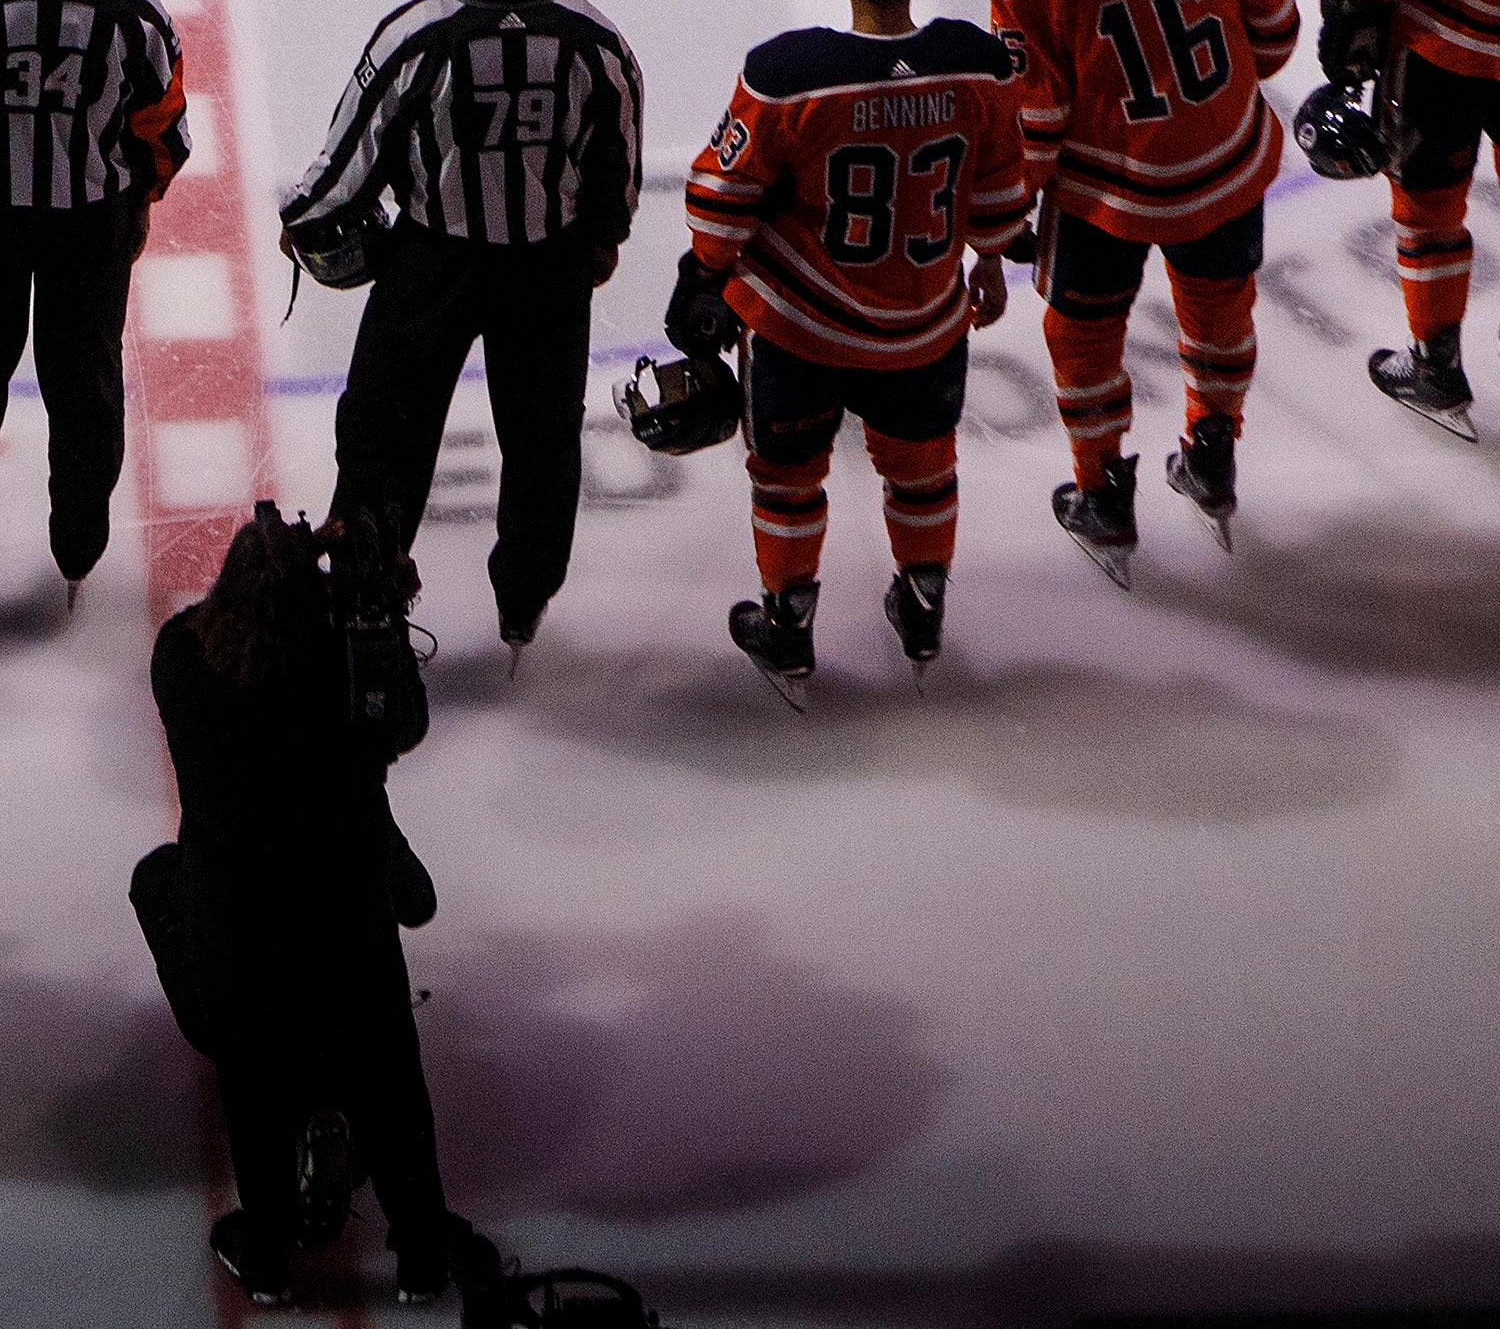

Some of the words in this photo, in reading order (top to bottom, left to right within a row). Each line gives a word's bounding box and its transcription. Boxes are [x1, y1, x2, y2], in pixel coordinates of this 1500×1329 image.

[3, 49, 85, 110] 34
[472, 87, 556, 148] 79
[851, 90, 957, 134] BENNING
[821, 133, 969, 270] 83
